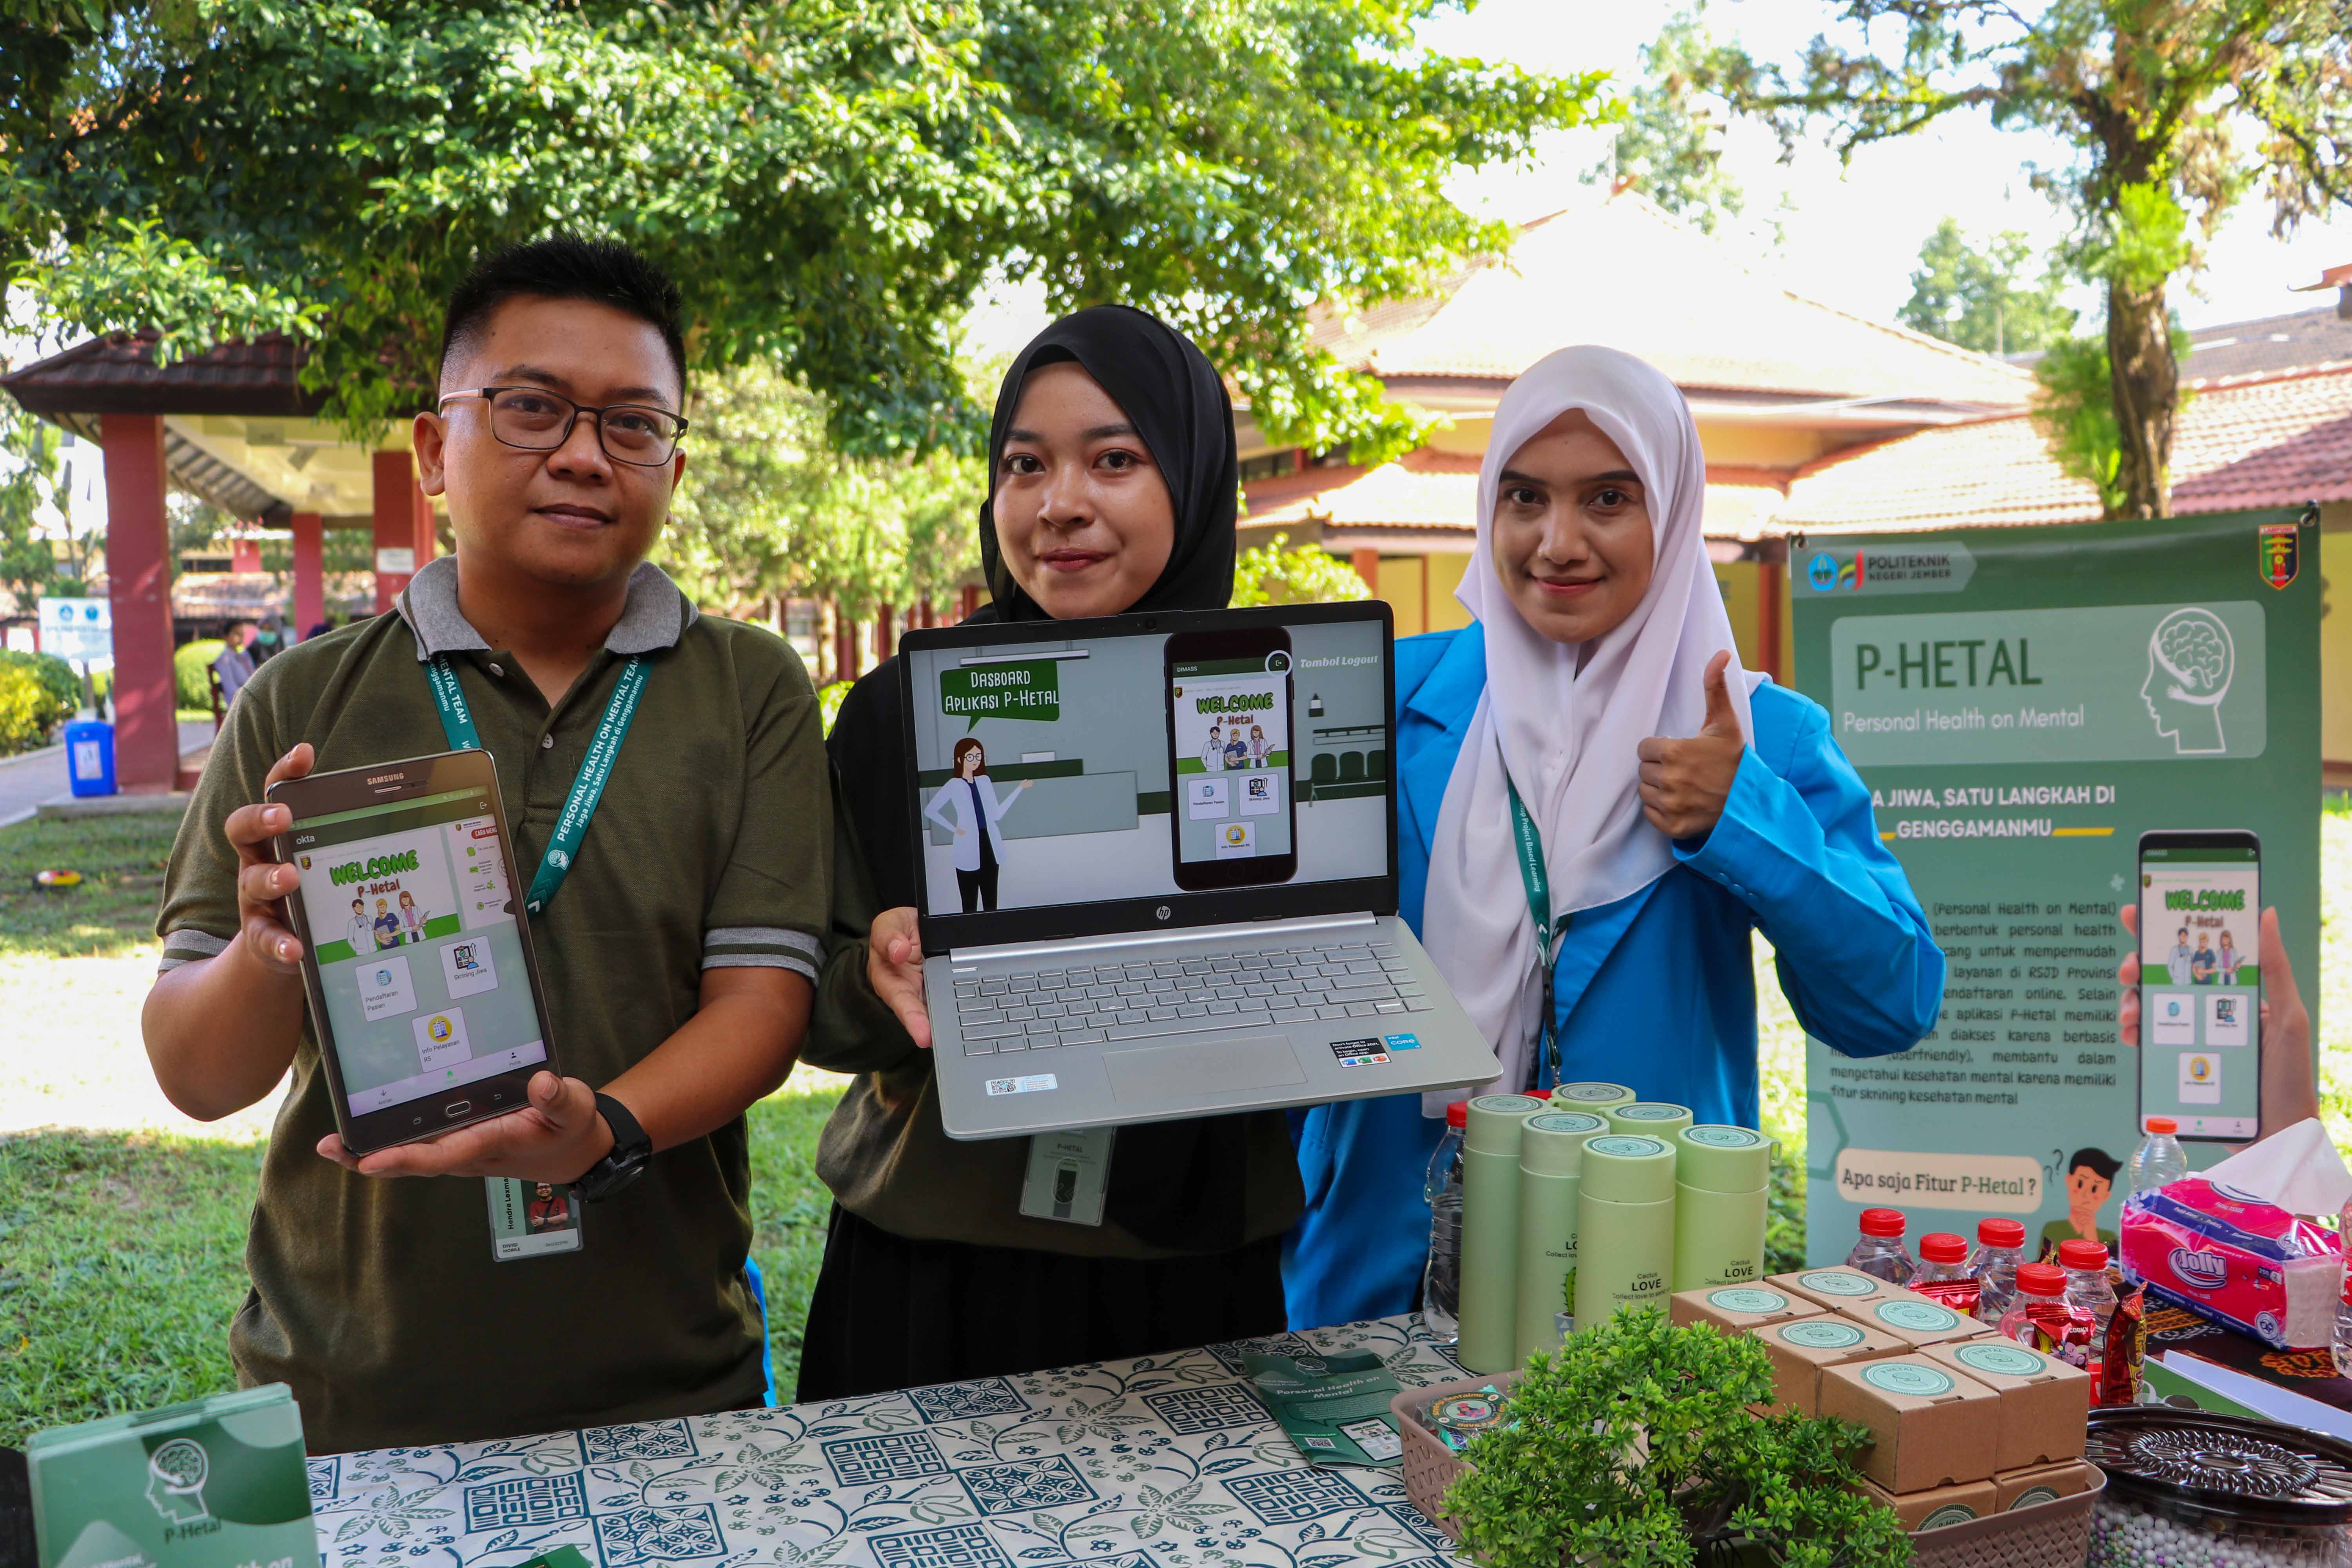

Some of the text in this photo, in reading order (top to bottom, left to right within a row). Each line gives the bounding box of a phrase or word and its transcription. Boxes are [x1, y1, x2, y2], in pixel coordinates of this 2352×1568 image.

[1868, 554, 1950, 569] POLITEKNIK
[1869, 568, 1951, 581] NEGERI JEMBER
[1300, 655, 1378, 668] Tombol Logout
[1856, 638, 2042, 690] P-HETAL
[429, 661, 450, 712] enggamanmu
[971, 670, 1031, 688] DASBOARD
[439, 653, 468, 724] MENTAL TEAM
[945, 689, 1060, 711] APLIKASI P-HETAL
[1196, 692, 1274, 715] WELCOME
[1216, 714, 1254, 726] P-Hetal
[1844, 704, 2084, 732] Personal Health on Mental
[557, 655, 640, 842] PERSONAL HEALTH ON MENTAL TEAM
[576, 675, 643, 828] Jaga Jiwa, Satu Langkah di Genggamanmu
[367, 773, 404, 785] SAMSUNG
[1888, 785, 2115, 809] JIWA, SATU LANGKAH DI
[1896, 818, 2052, 838] GENGGAMANMU
[296, 834, 316, 845] okta
[1522, 818, 1541, 892] Project Based Learning
[329, 849, 419, 887] WELCOME
[357, 879, 401, 898] P-Hetal
[2165, 889, 2246, 911] WELCOME
[1158, 906, 1169, 920] hp
[1933, 902, 2116, 916] (Personal Health on Mental)
[2185, 915, 2224, 930] P-Hetal
[1935, 924, 2116, 938] berbentuk personal health
[1980, 946, 2116, 959] untuk mempermudah
[454, 971, 475, 981] Skrining
[1954, 966, 2116, 980] layanan di RSJD Provinsi
[365, 990, 398, 1003] Pendaftaran
[1943, 987, 2116, 1000] endaftaran online. Selain
[367, 1002, 386, 1011] Pasien
[1956, 1008, 2003, 1022] aplikasi
[2011, 1009, 2056, 1020] P-Hetal
[2065, 1009, 2116, 1022] memiliki
[1951, 1030, 1996, 1042] diakses
[2008, 1031, 2051, 1043] karena
[2063, 1031, 2116, 1043] berbasis
[422, 1040, 460, 1054] Info Pelayanan
[1993, 1051, 2058, 1063] membantu
[2078, 1053, 2116, 1065] dalam
[1830, 1066, 2116, 1087] mengetahui kesehatan mental karena memiliki
[1831, 1086, 2018, 1104] fitur skrining kesehatan mental
[1843, 1168, 2037, 1196] Apa saja Fitur P-Hetal ?
[2176, 1248, 2227, 1277] Jolly
[1725, 1266, 1753, 1278] LOVE
[1632, 1278, 1662, 1291] LOVE
[1276, 1387, 1325, 1395] Personal
[1327, 1379, 1363, 1391] Health
[1314, 1388, 1353, 1399] Mental
[164, 1519, 221, 1544] P-Hetal
